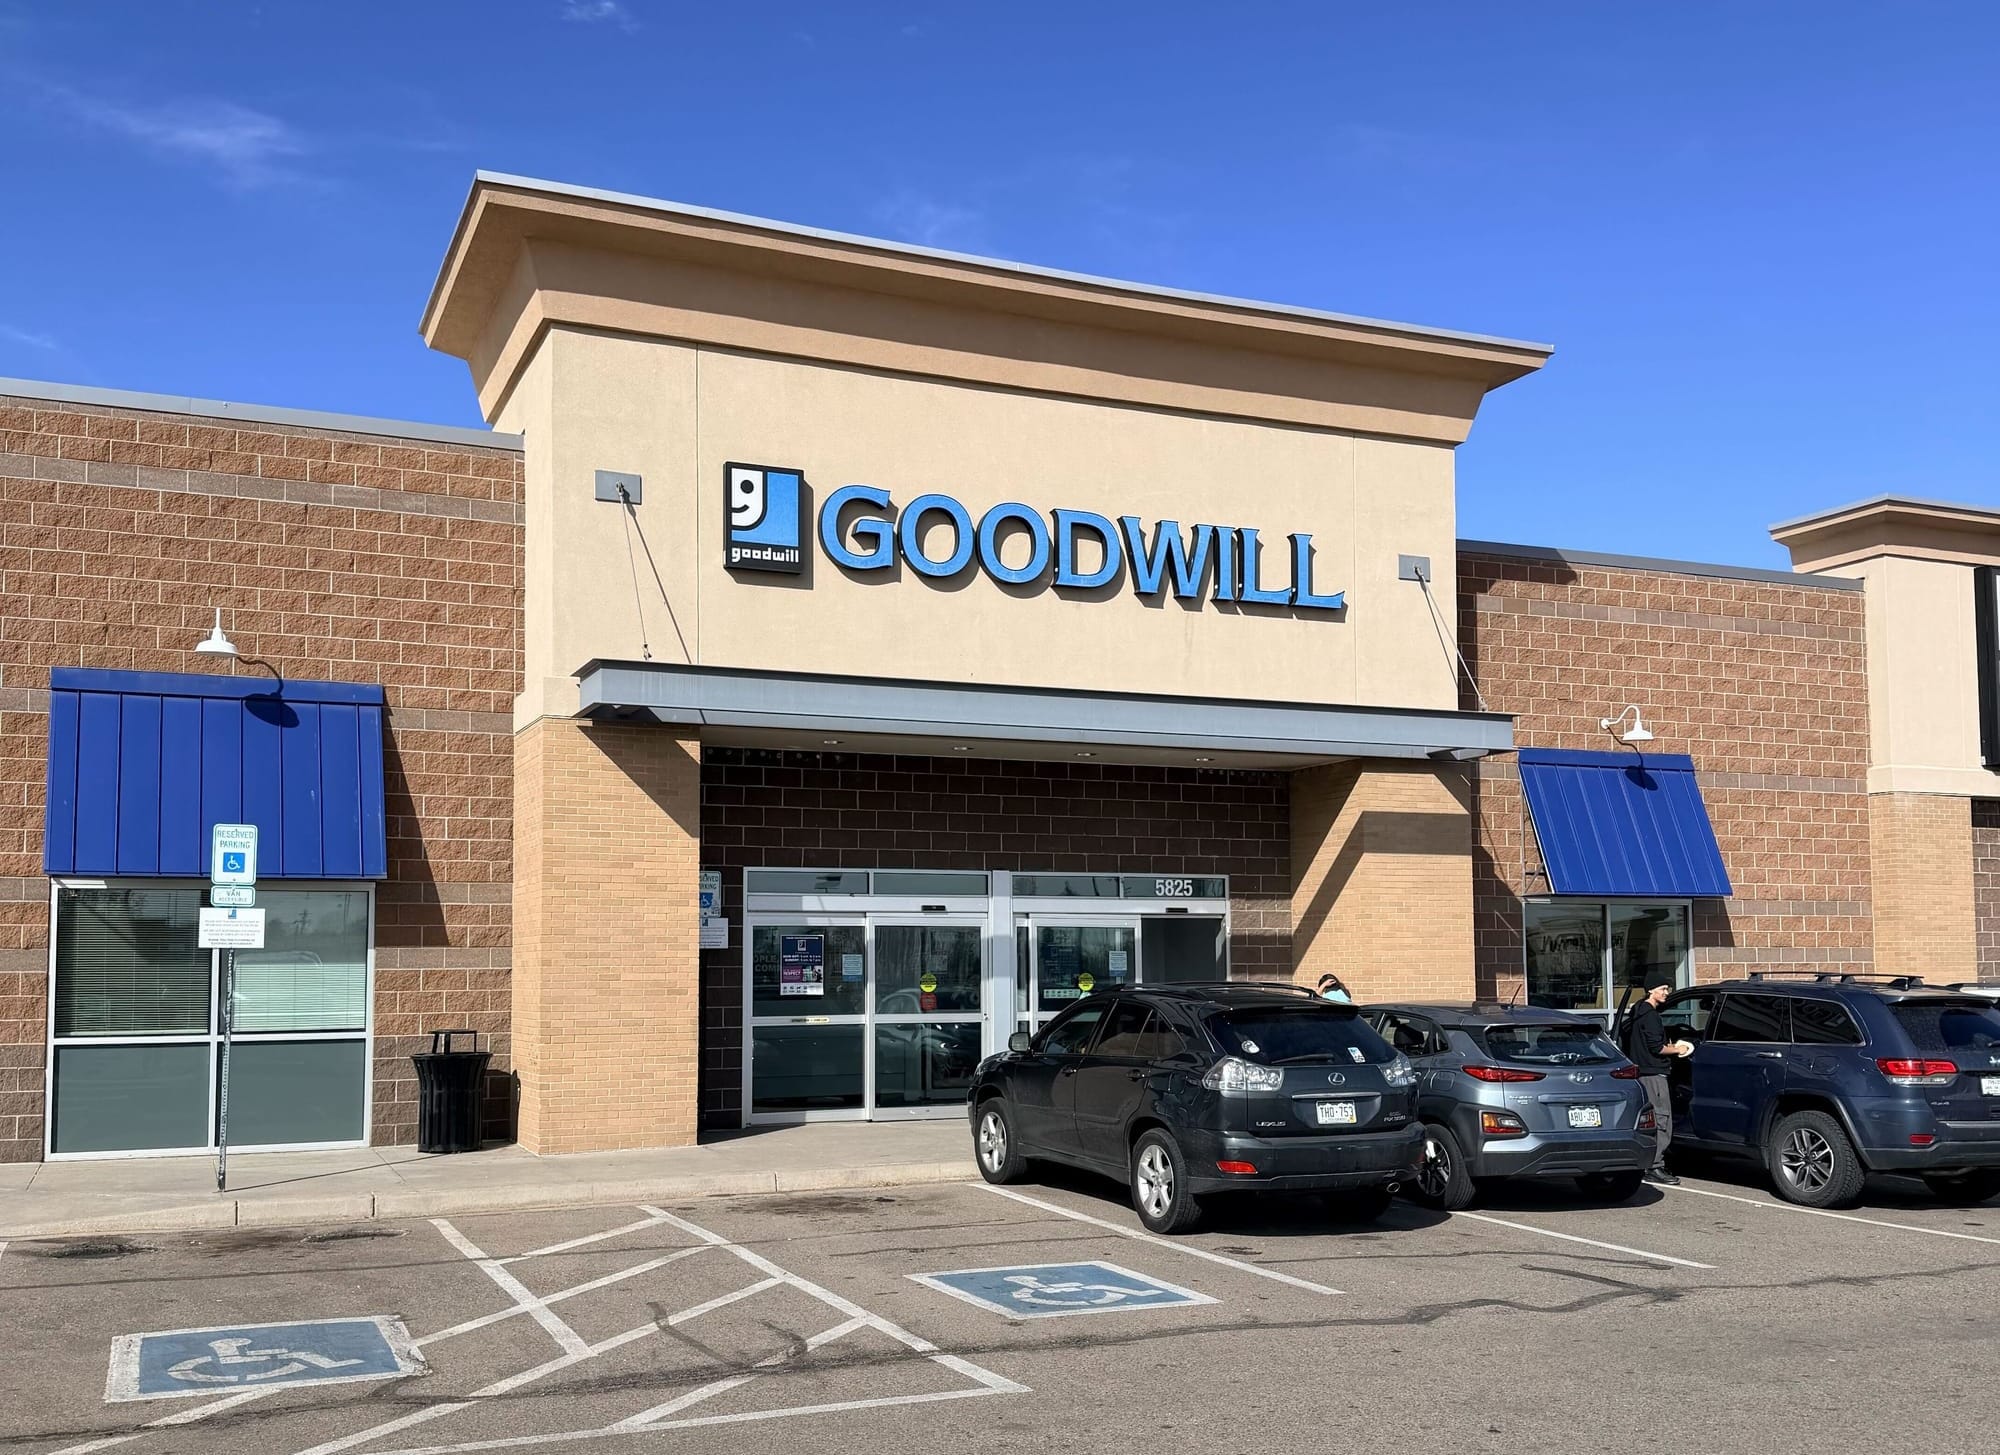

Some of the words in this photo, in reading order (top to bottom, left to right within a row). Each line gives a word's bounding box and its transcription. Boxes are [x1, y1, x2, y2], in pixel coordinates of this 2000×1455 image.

[818, 484, 1346, 609] GOODWILL
[731, 547, 799, 563] goodwill
[217, 829, 254, 839] RESERVED
[219, 840, 251, 849] PARKING
[1155, 879, 1193, 896] 5825
